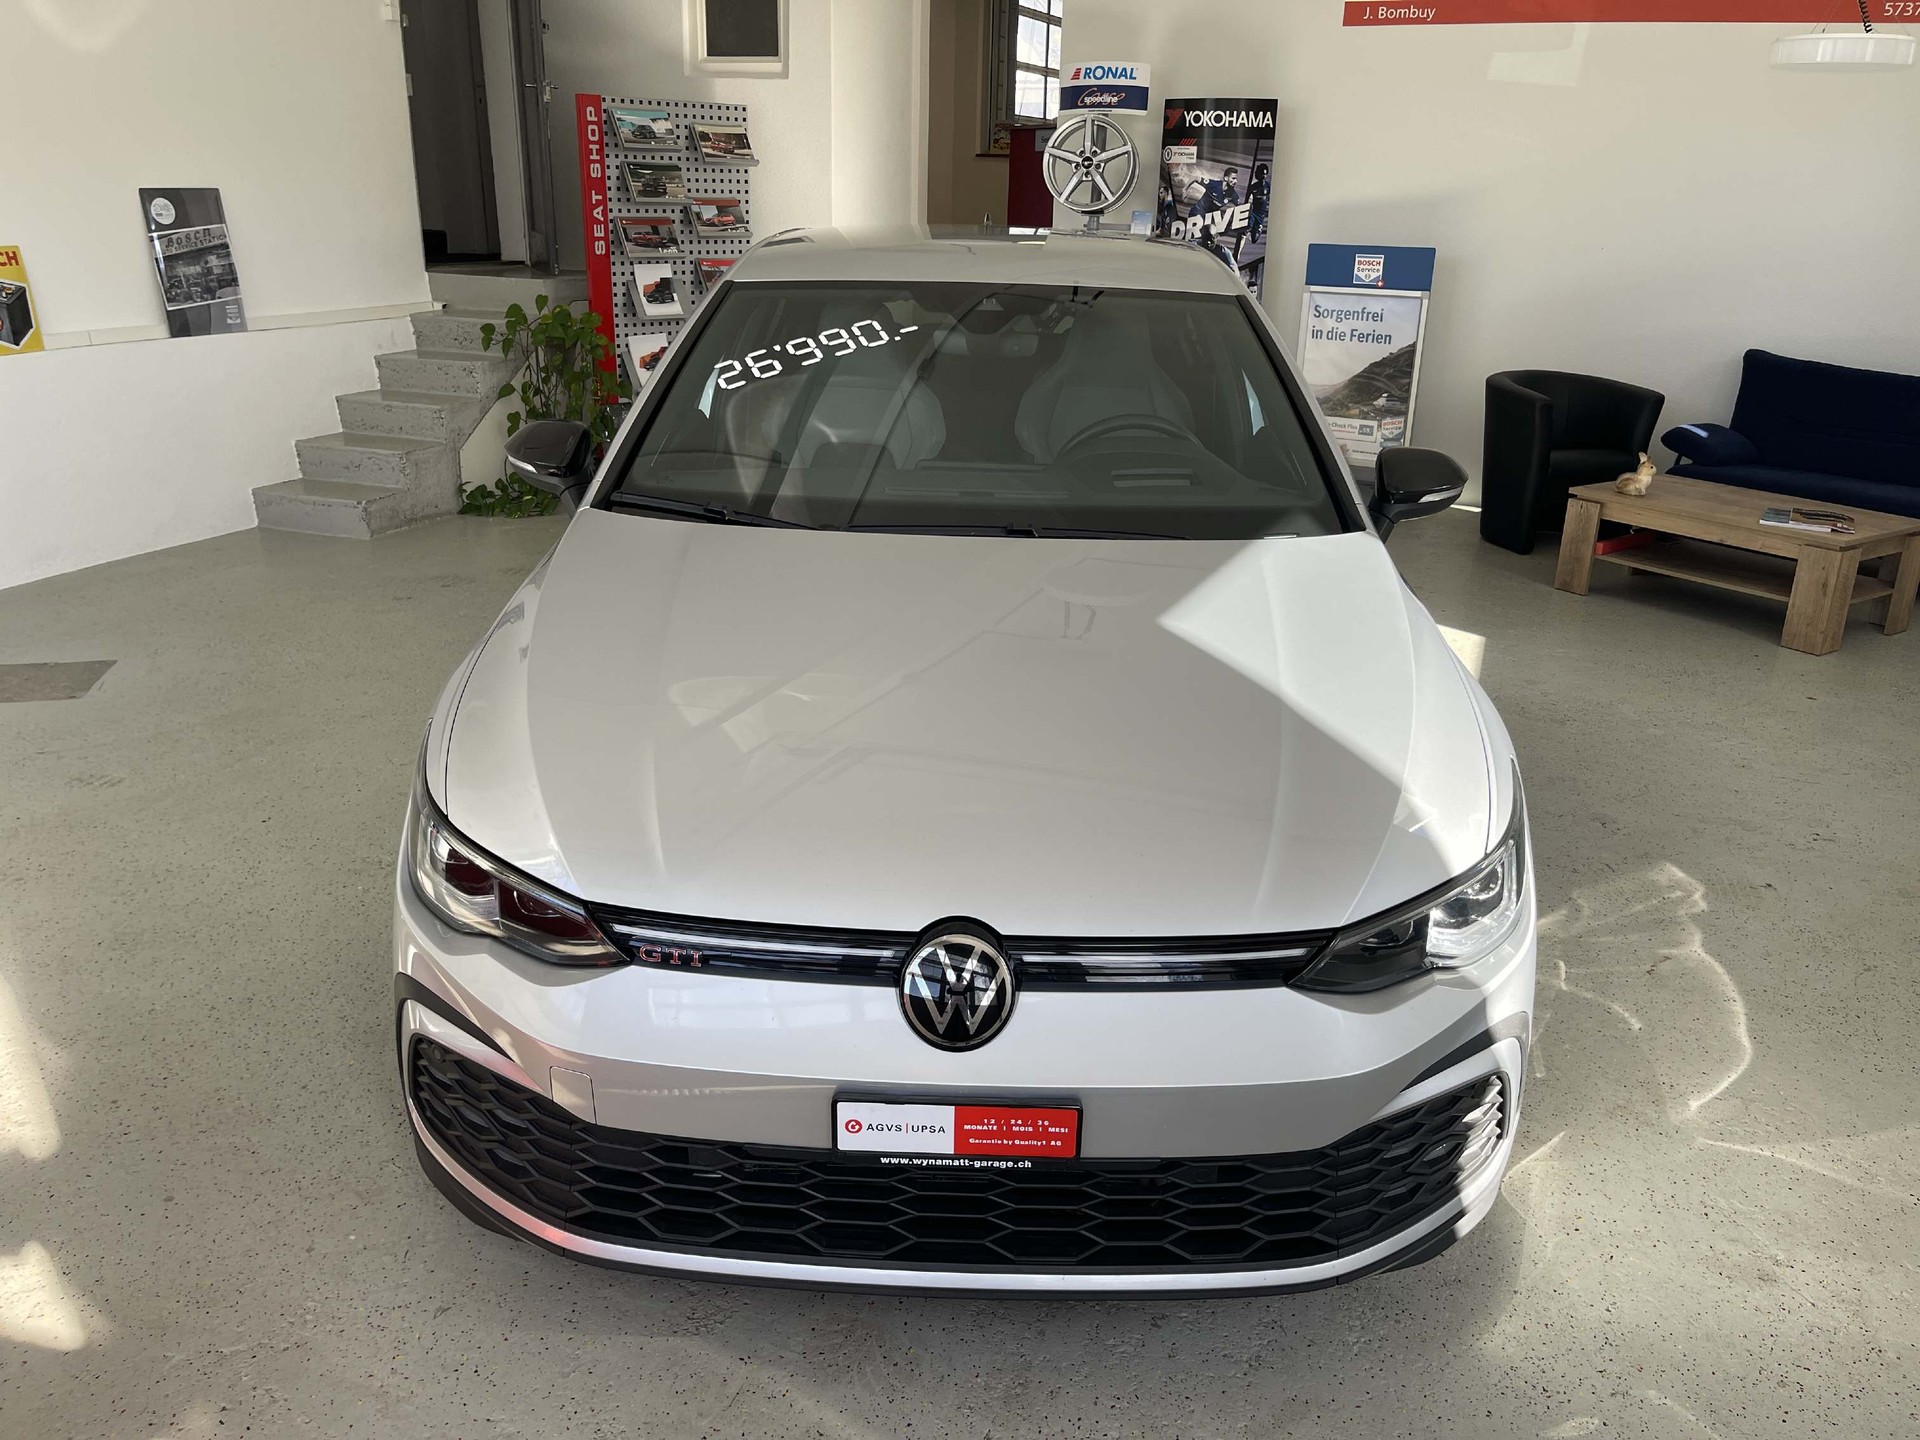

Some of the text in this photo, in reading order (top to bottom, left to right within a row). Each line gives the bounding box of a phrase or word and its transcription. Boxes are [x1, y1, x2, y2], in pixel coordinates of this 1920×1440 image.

[1363, 5, 1437, 21] J. Bombuy
[1083, 65, 1137, 81] RONAL
[1184, 110, 1274, 128] YOKOHAMA
[586, 106, 607, 255] SEAT SHOP
[1170, 202, 1251, 241] DRIVE
[1357, 259, 1382, 267] BOSCH
[1313, 304, 1385, 323] Sorgenfrei
[1311, 325, 1393, 345] in die Ferien
[1382, 419, 1403, 427] BOSCH
[640, 943, 702, 967] GTI
[866, 1123, 946, 1134] AGVS UPSA
[1003, 1138, 1013, 1147] by
[1014, 1139, 1046, 1147] Quality1
[880, 1156, 1032, 1169] www.wynamatt-garage.ch
